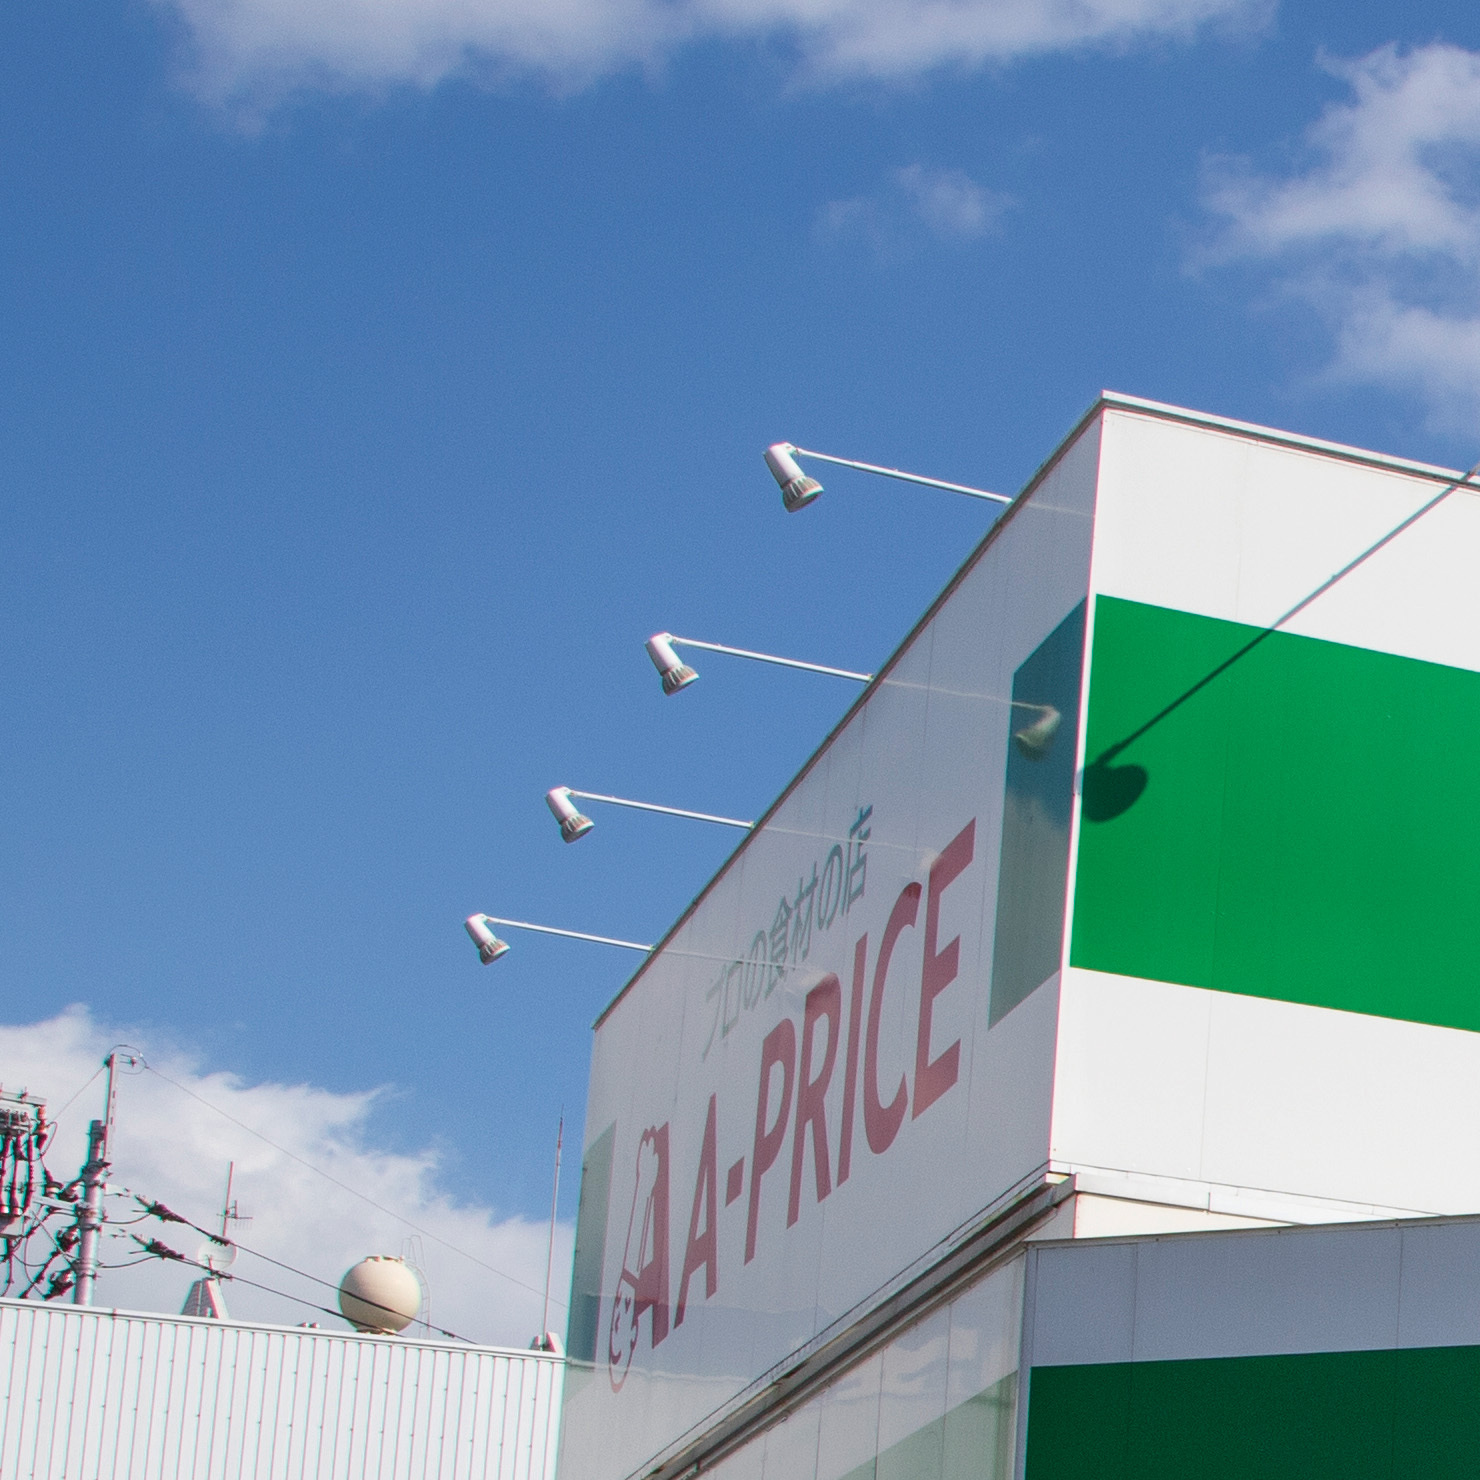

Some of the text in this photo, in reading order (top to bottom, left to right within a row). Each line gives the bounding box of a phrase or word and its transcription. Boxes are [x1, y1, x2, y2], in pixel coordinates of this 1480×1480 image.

[674, 817, 976, 1329] A-PRICE
[701, 804, 873, 1062] プロの食材の店
